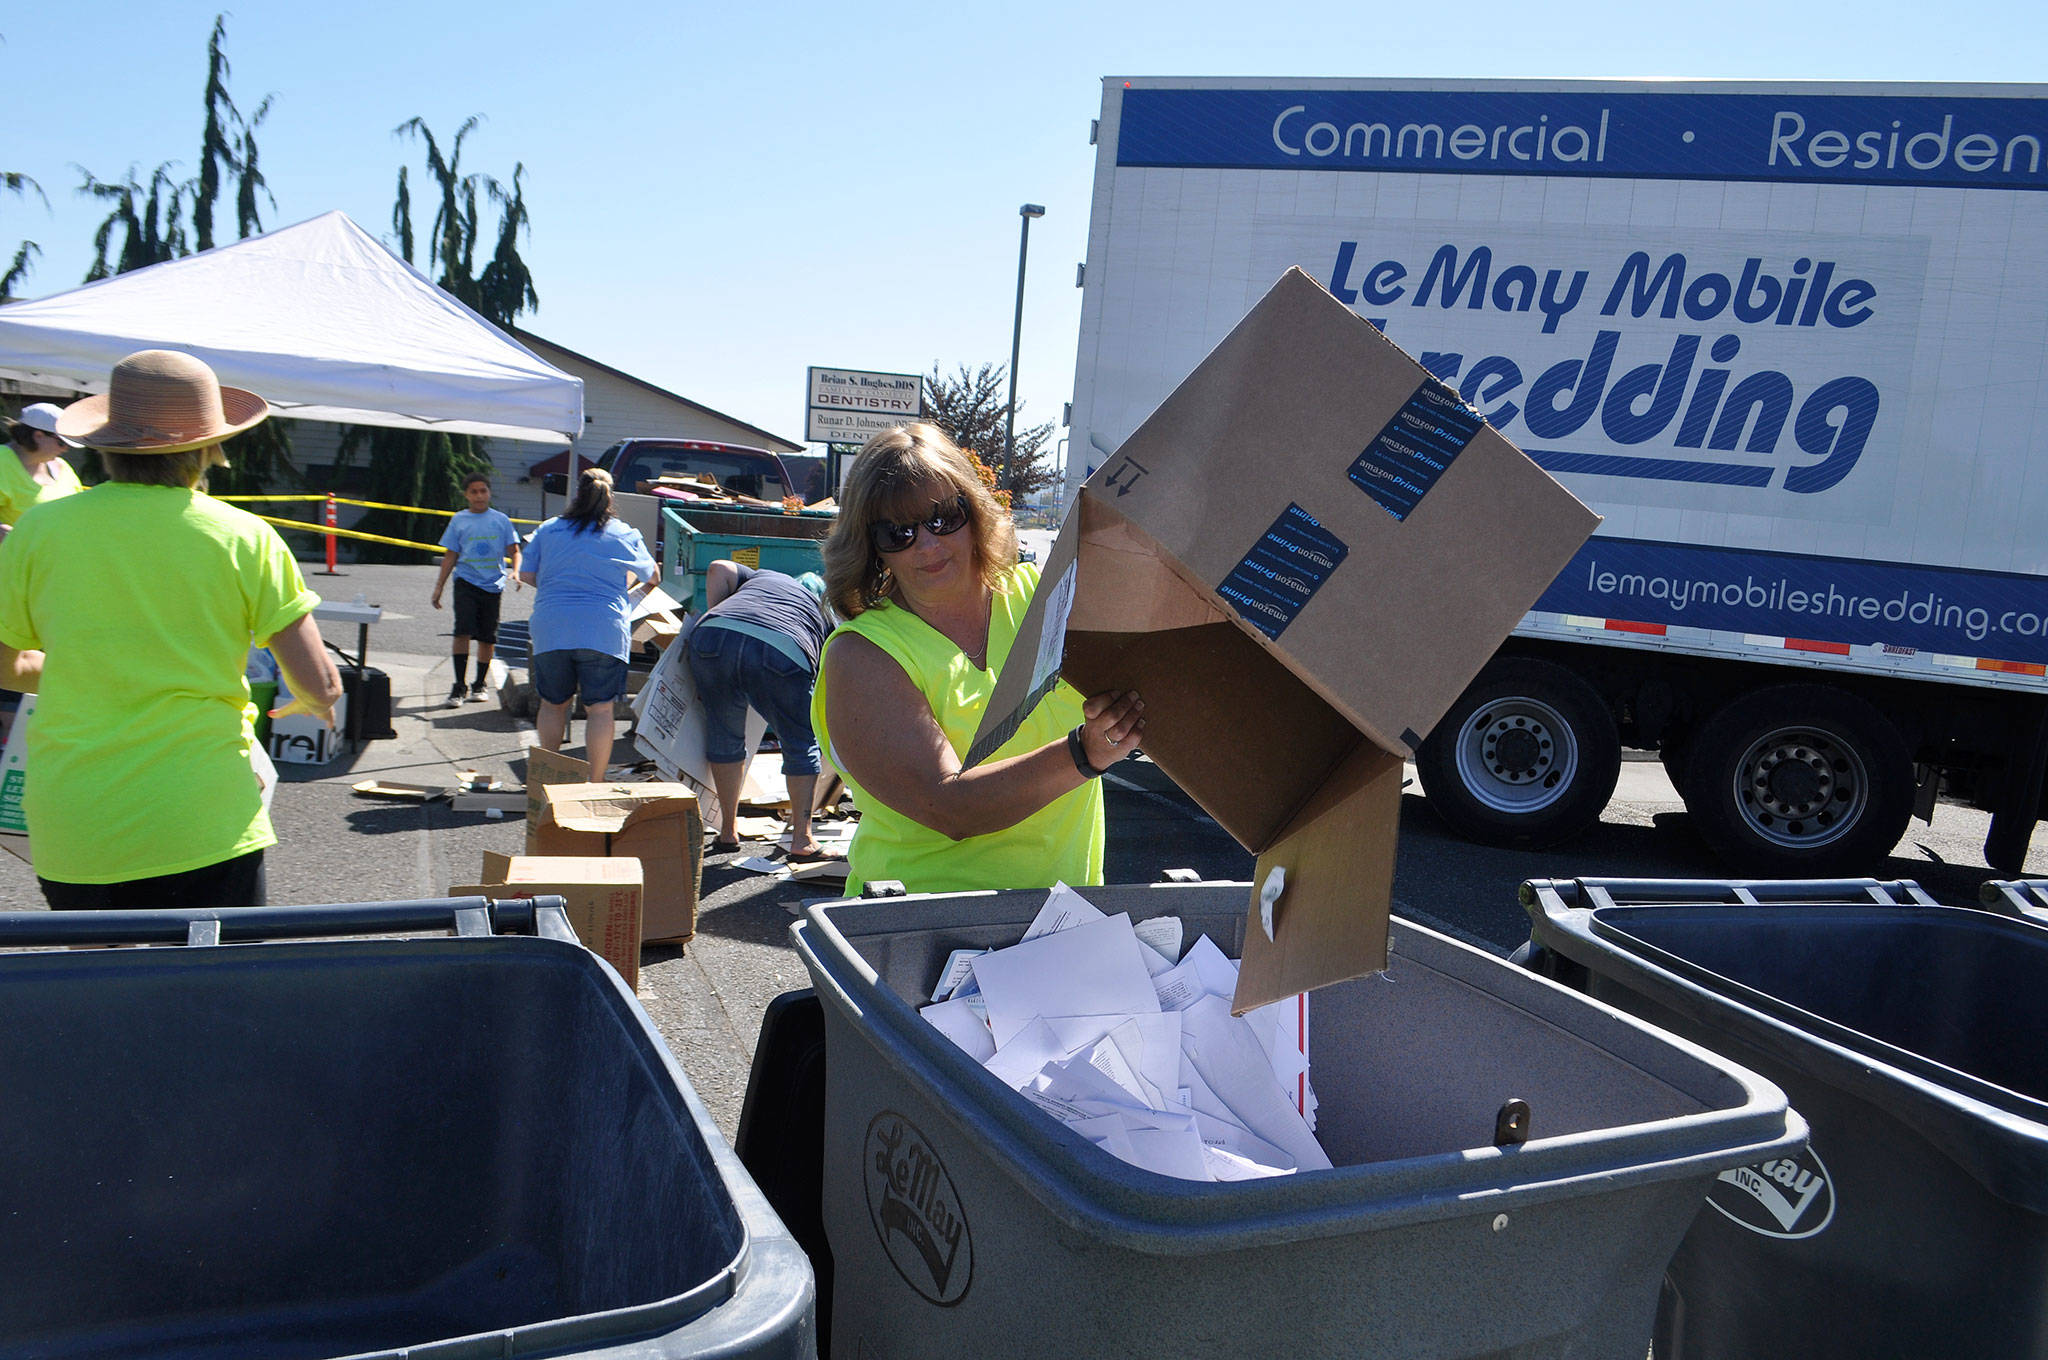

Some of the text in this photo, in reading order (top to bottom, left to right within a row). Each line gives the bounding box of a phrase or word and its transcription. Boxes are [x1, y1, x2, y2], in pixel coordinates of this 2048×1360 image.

[1273, 105, 2048, 174] Commercial Residen
[1601, 251, 1876, 328] Mobile
[821, 374, 846, 385] Brian
[817, 414, 844, 426] Runar
[818, 394, 912, 410] DENTISTRY
[1367, 318, 1881, 495] redding
[830, 431, 872, 440] DENT
[1401, 411, 1464, 447] amazonPrime
[1380, 434, 1445, 471] amazonPrime
[1359, 458, 1424, 496] amazonPrime
[1267, 532, 1333, 569] amazonPrime
[1244, 558, 1311, 596] amazonPrime
[1221, 584, 1288, 623] amazonPrime
[1588, 561, 2048, 641] lemaymobileshredding.co
[1735, 1167, 1763, 1197] INC.
